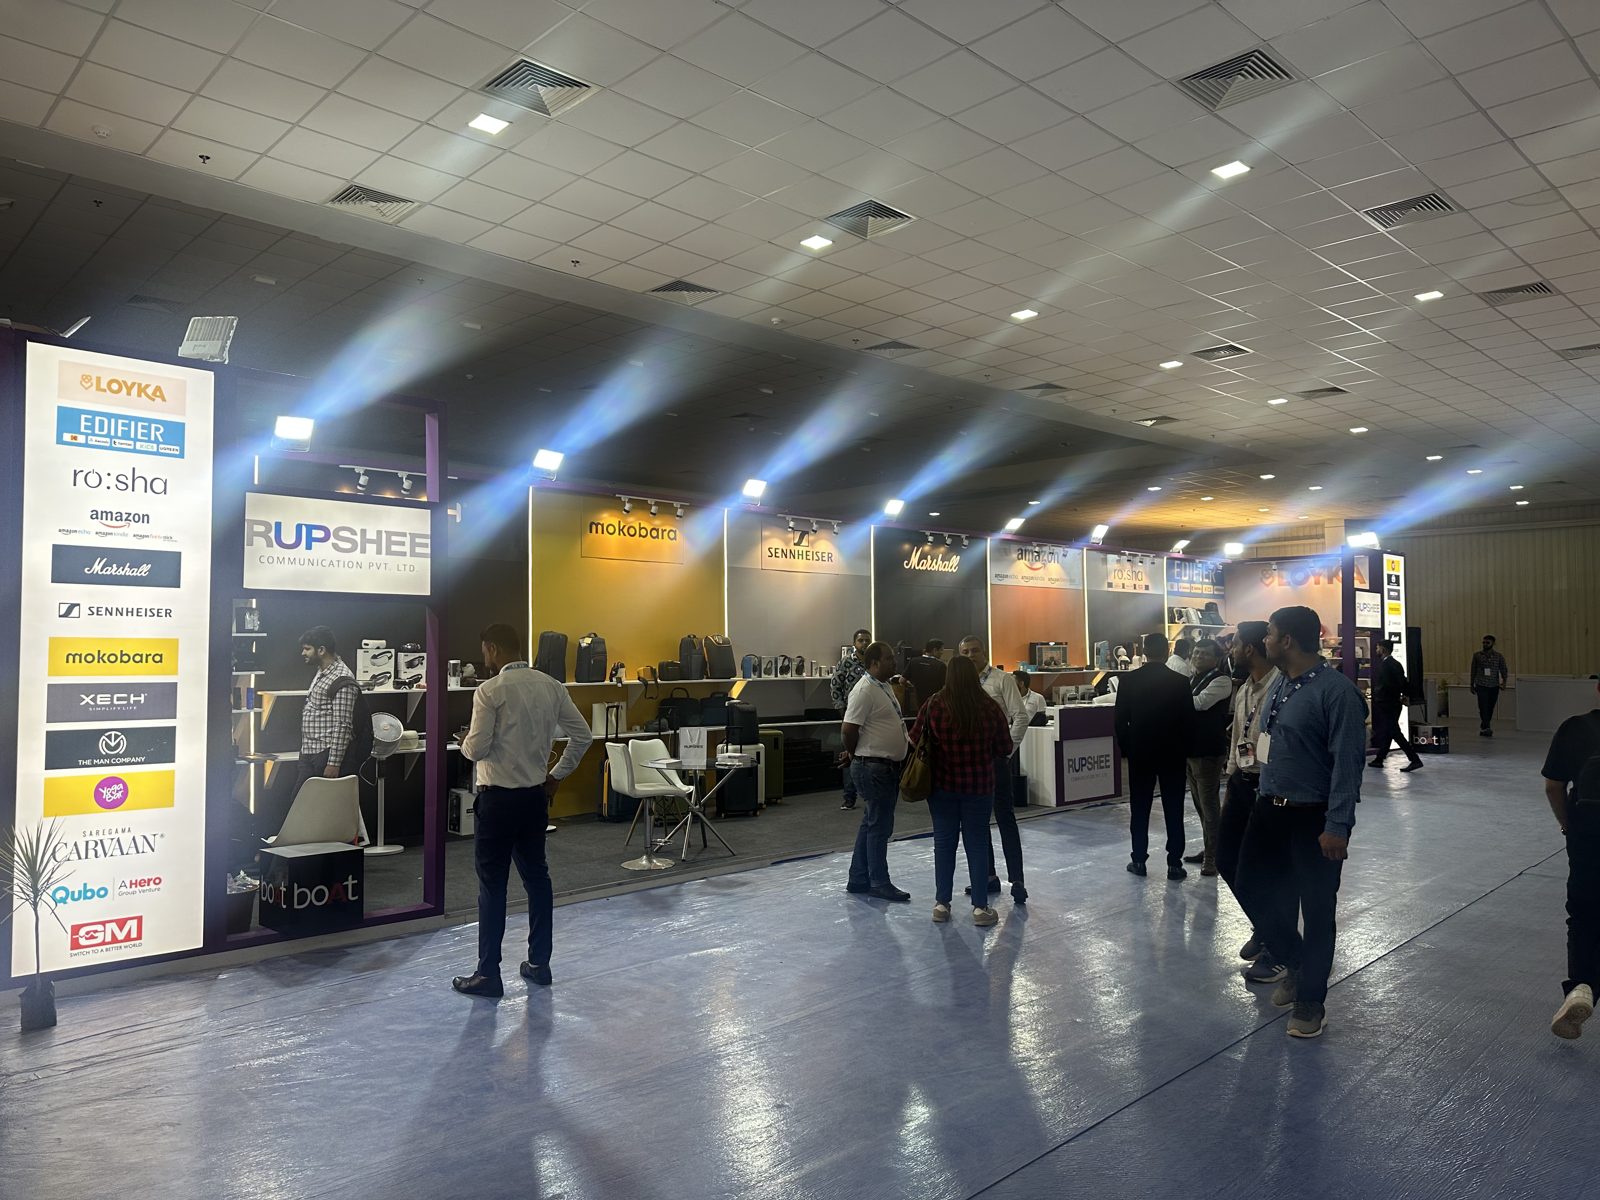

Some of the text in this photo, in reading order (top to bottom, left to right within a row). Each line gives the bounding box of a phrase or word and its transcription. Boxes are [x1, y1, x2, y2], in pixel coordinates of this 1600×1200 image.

[95, 376, 167, 402] LOYKA
[80, 414, 164, 443] EDIFIER
[73, 467, 168, 495] ro:sha
[90, 509, 150, 524] amazon
[246, 519, 431, 558] RUPSHEE
[588, 520, 678, 541] mokobara
[258, 555, 363, 570] COMMUNICATION
[768, 547, 834, 563] SENNHEISER
[903, 545, 960, 573] Marshall
[1017, 547, 1060, 564] amazon
[84, 557, 151, 577] Marshall
[1174, 560, 1216, 583] EDIFIER
[88, 606, 172, 618] SENNHEISER
[65, 649, 164, 665] mokobara
[80, 693, 145, 705] XECH
[111, 756, 146, 764] COMPANY
[1067, 754, 1111, 774] RUPSHEE
[83, 827, 132, 837] SAREGAMA
[51, 876, 162, 904] Qubo A Hero
[118, 889, 137, 897] Group
[72, 918, 138, 946] GM
[70, 950, 91, 958] SWITCH
